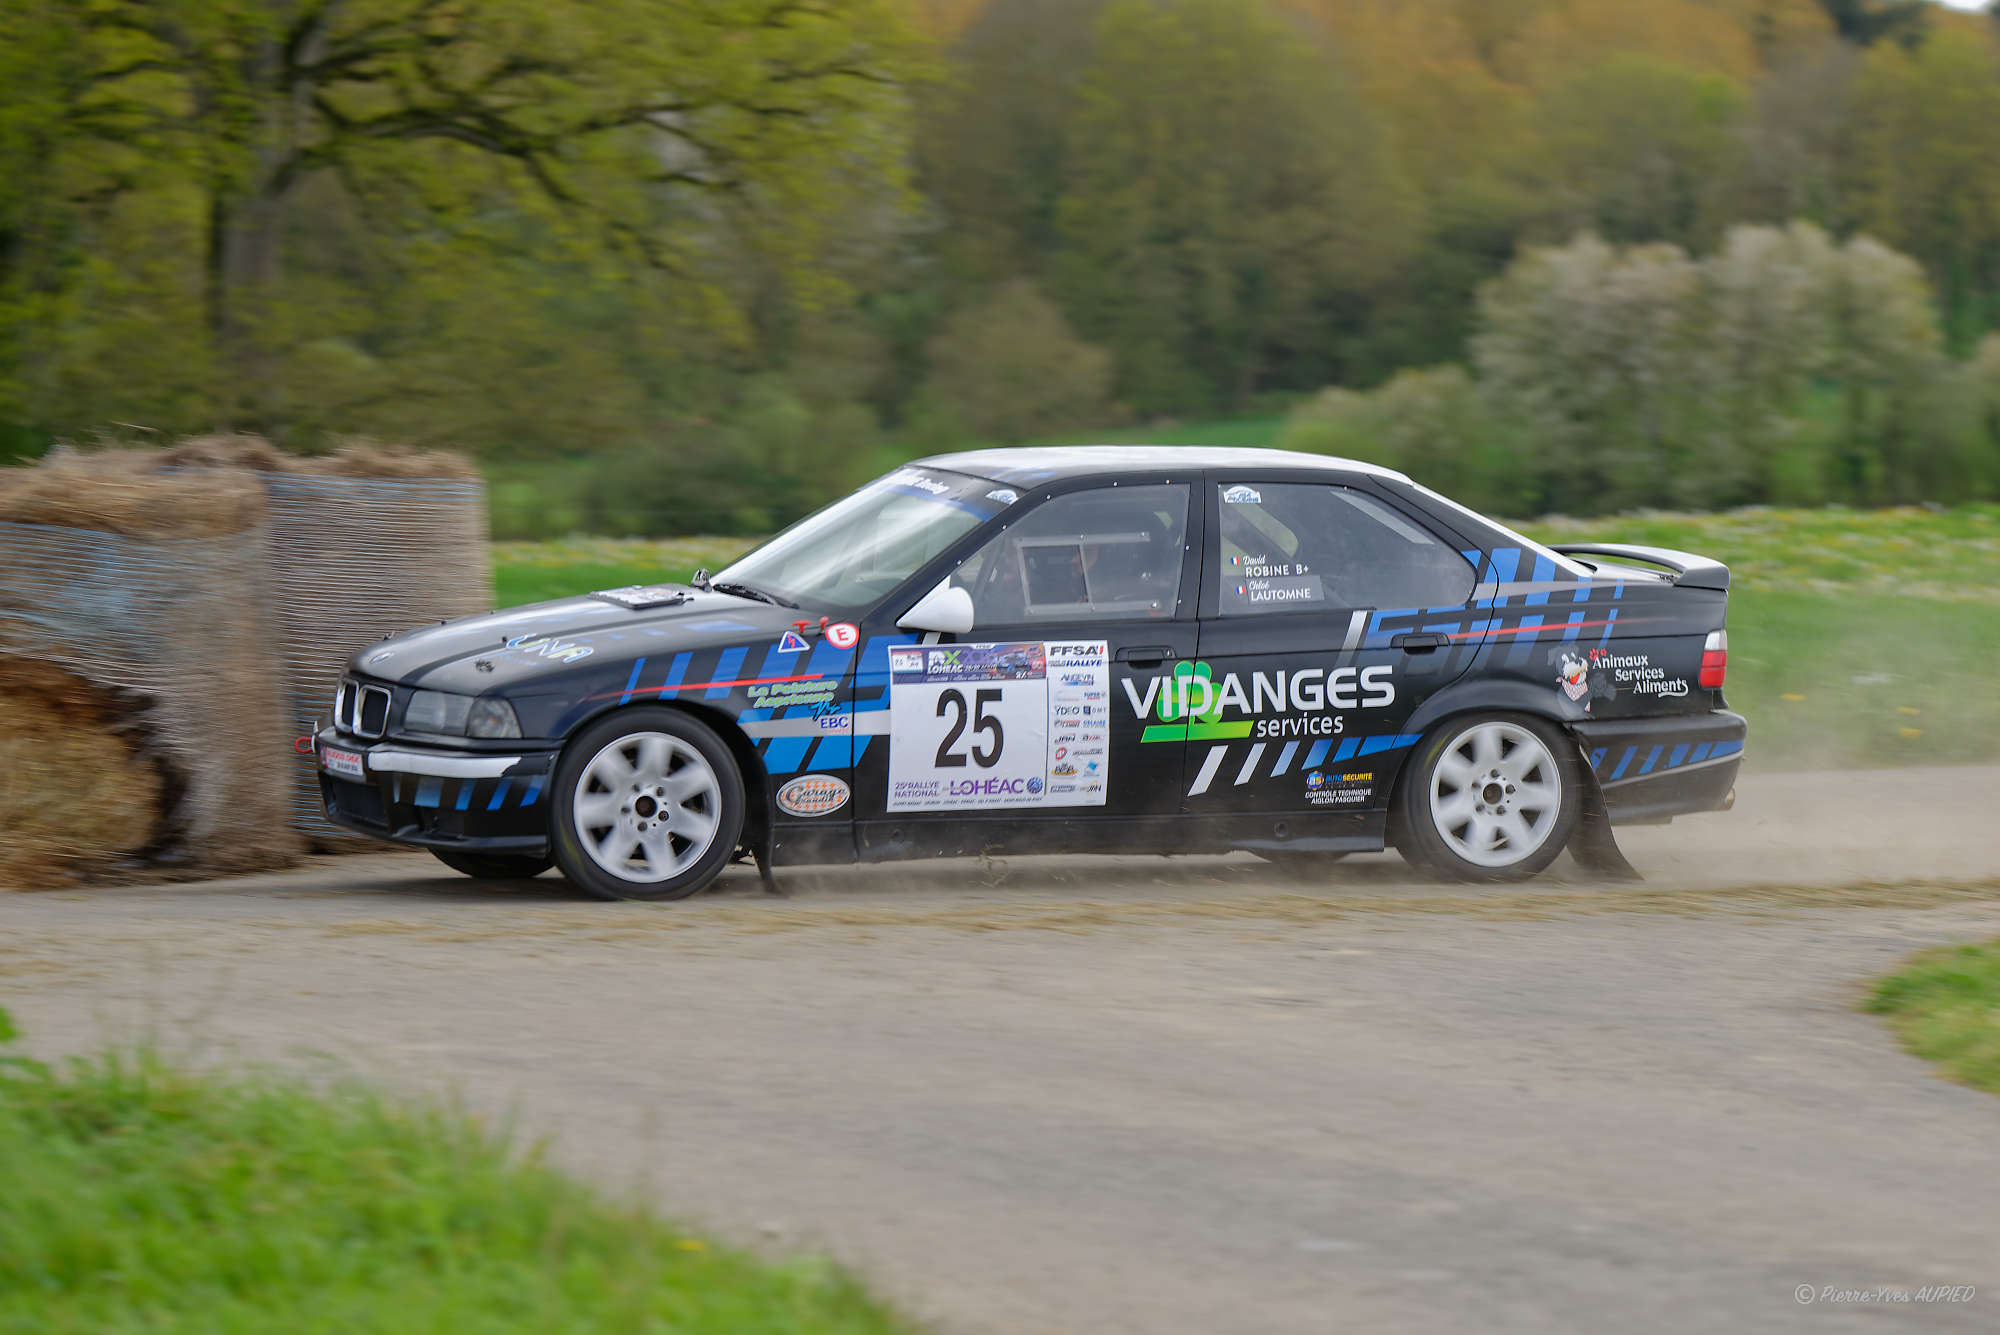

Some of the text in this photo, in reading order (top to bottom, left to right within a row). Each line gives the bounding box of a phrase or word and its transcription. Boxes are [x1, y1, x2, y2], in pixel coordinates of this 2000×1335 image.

[1242, 554, 1266, 565] David
[1245, 563, 1309, 578] ROBINE B+
[1250, 588, 1312, 602] LAUTOMNE
[836, 627, 849, 641] E
[1050, 645, 1098, 657] FFSA
[1592, 653, 1650, 670] Animaux
[1615, 666, 1665, 682] Services
[746, 680, 838, 698] La Peinture
[1121, 665, 1396, 720] VIDANGES
[1633, 677, 1690, 698] Aliments
[820, 716, 849, 729] EBC
[934, 687, 1004, 768] 25
[1256, 711, 1344, 738] services
[905, 781, 939, 790] RALLYE
[950, 776, 1024, 796] LOHÉAC
[1338, 788, 1372, 797] TECHNIQUE
[894, 789, 939, 799] NATIONAL
